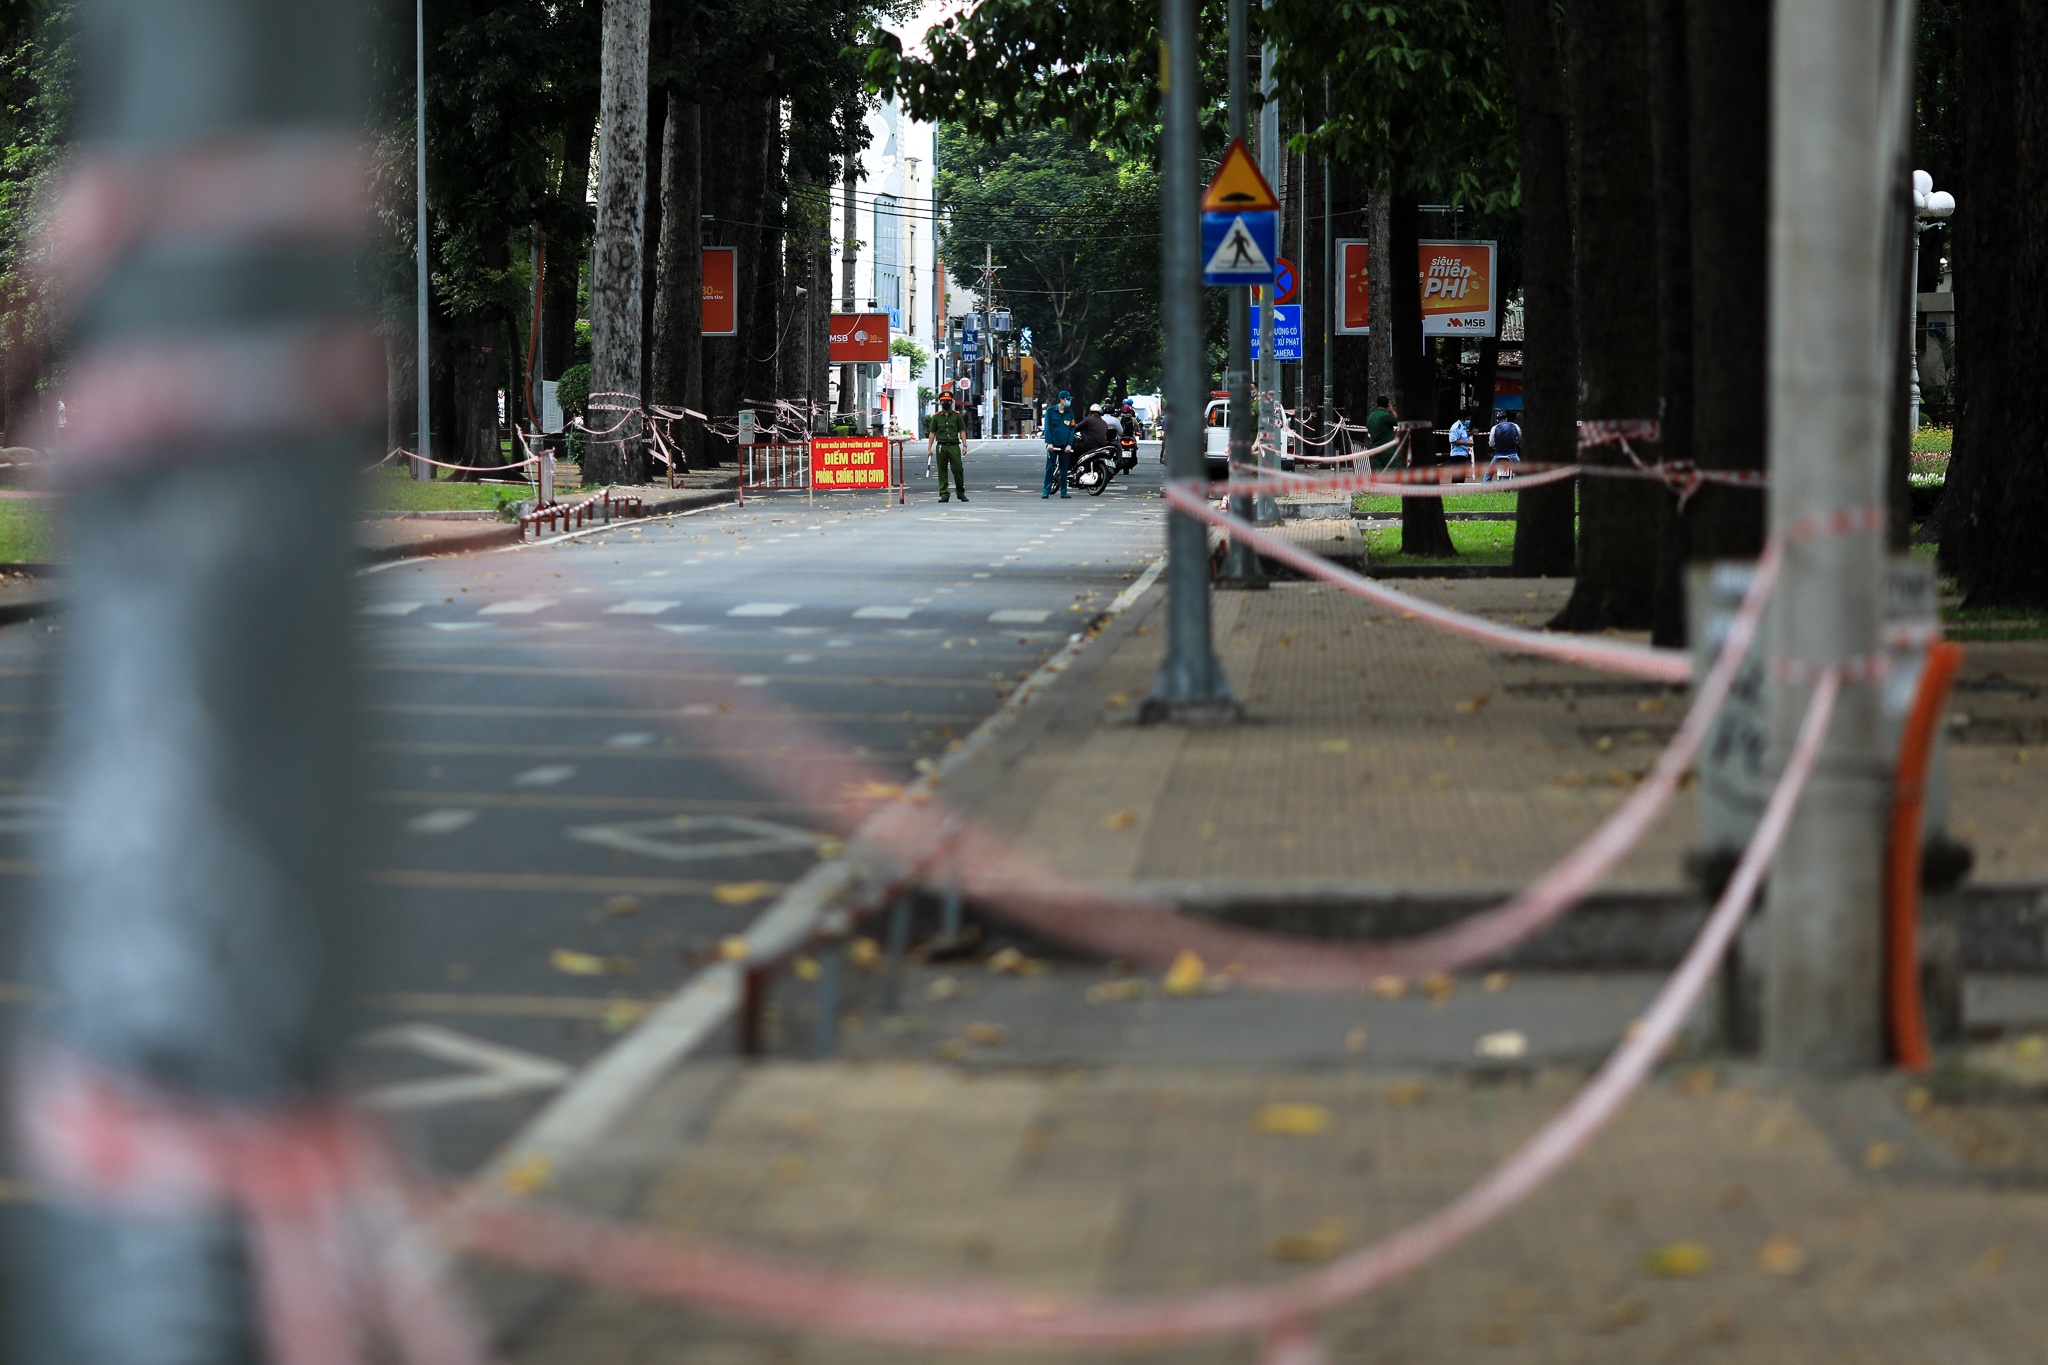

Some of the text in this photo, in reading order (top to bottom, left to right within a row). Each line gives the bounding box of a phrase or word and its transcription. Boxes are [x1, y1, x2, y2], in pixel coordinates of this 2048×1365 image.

[1431, 256, 1453, 266] siêu
[1424, 273, 1470, 298] PHÍ
[1464, 318, 1486, 327] MSB
[829, 334, 848, 342] MSB
[824, 449, 875, 465] ĐIỂM CHỐT
[815, 467, 835, 485] PHÒNG,
[836, 466, 854, 483] CHỐNG
